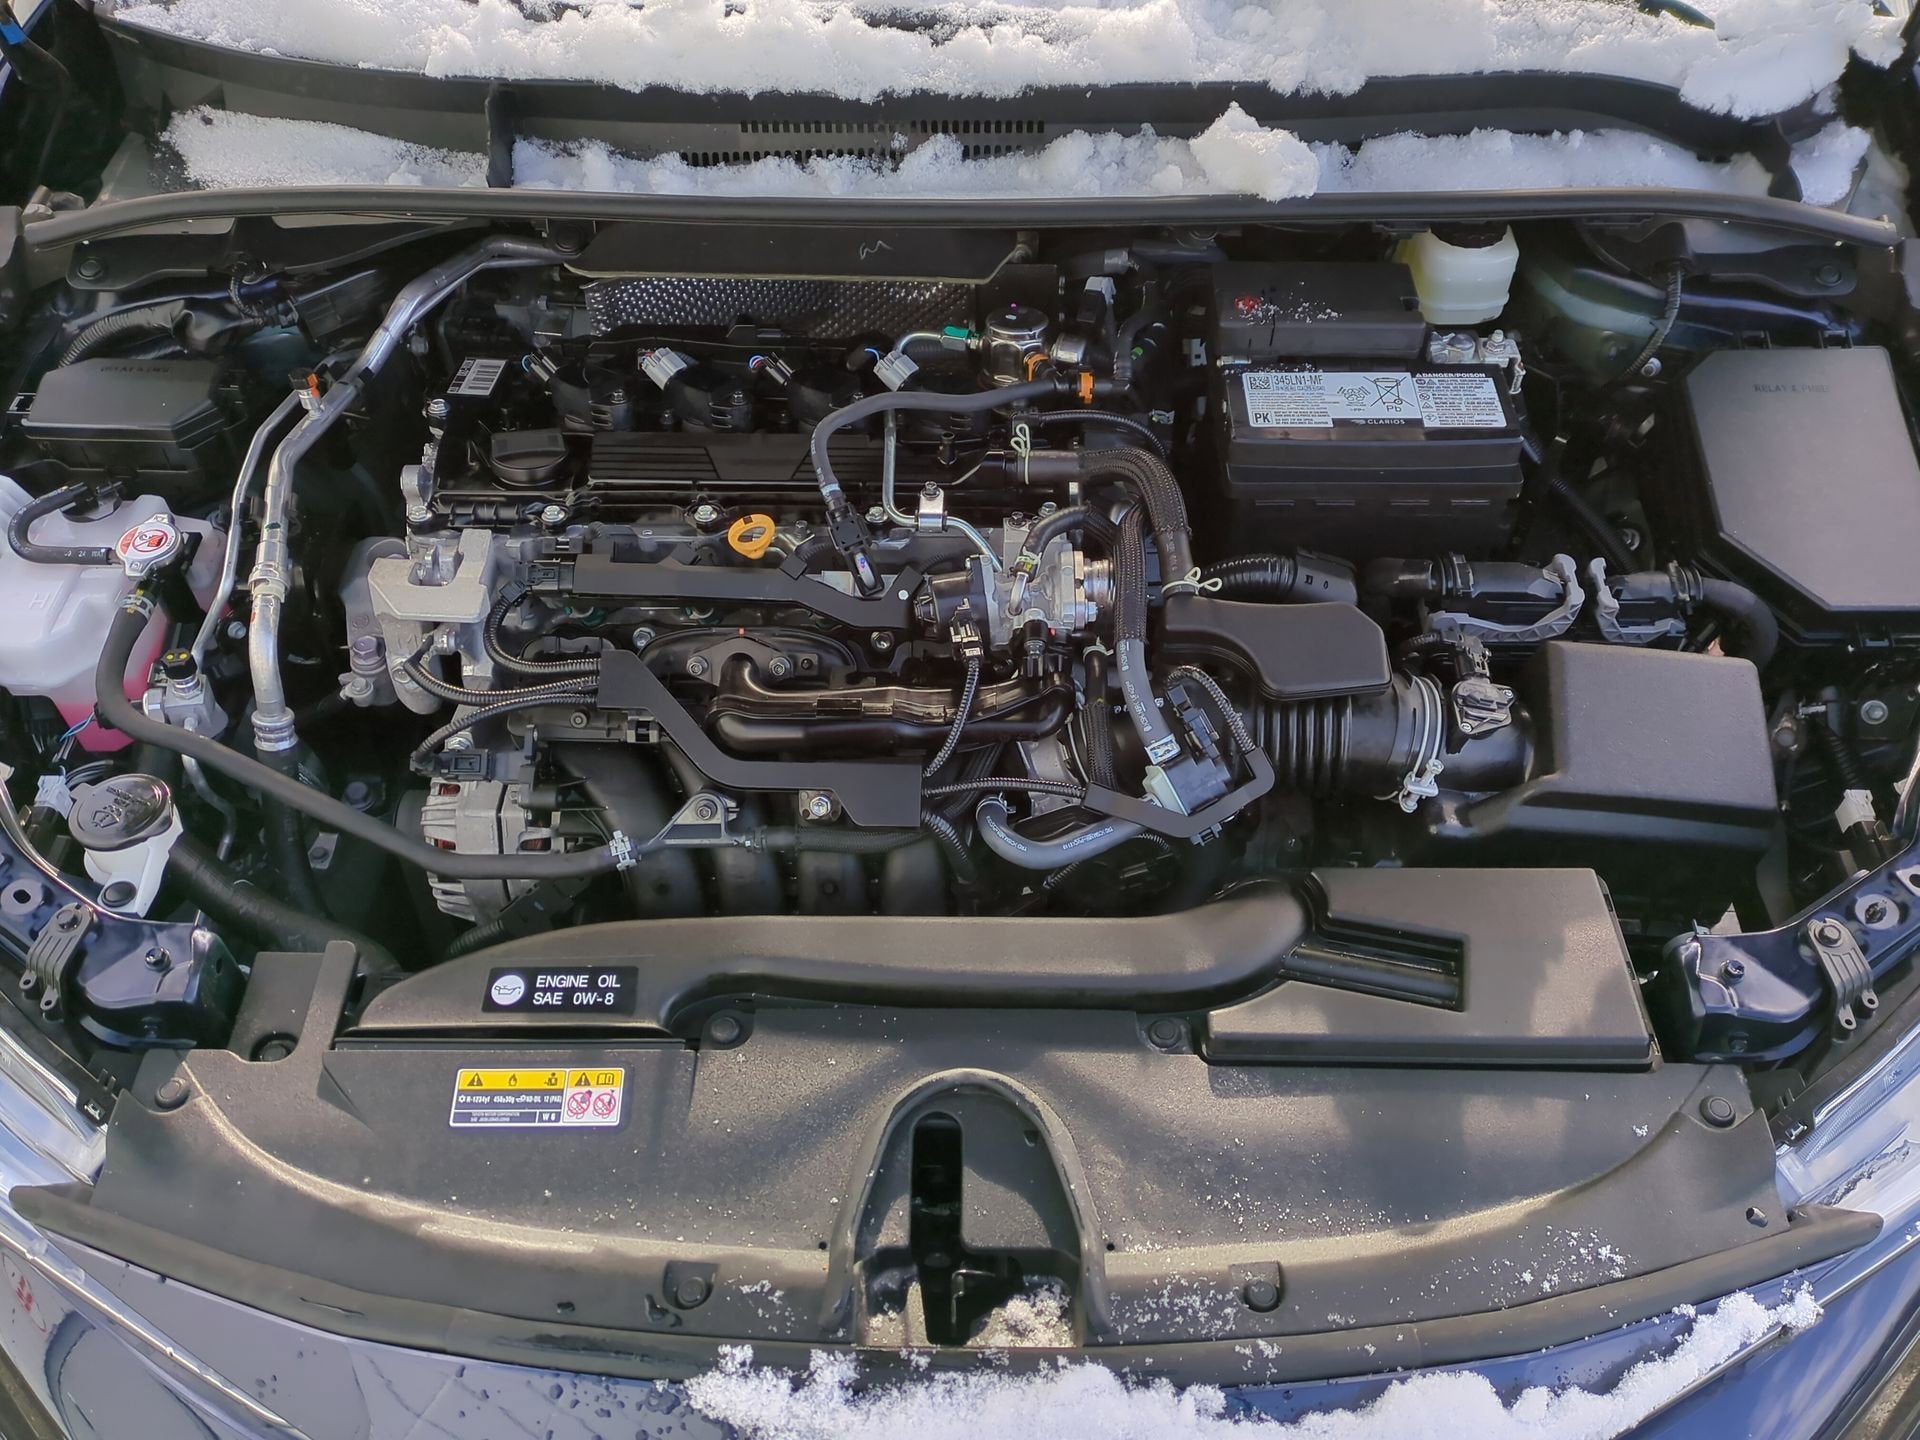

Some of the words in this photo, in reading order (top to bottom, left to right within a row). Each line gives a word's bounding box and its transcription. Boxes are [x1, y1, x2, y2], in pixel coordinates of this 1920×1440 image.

[1273, 374, 1324, 386] 345LN1-MF
[1386, 405, 1402, 413] Pb
[1254, 412, 1271, 424] PK
[535, 974, 590, 988] ENGINE
[597, 974, 621, 988] OIL
[532, 991, 563, 1006] SAE
[573, 991, 615, 1006] 0W-8
[466, 1095, 491, 1105] R-1234yf
[542, 1112, 550, 1121] W
